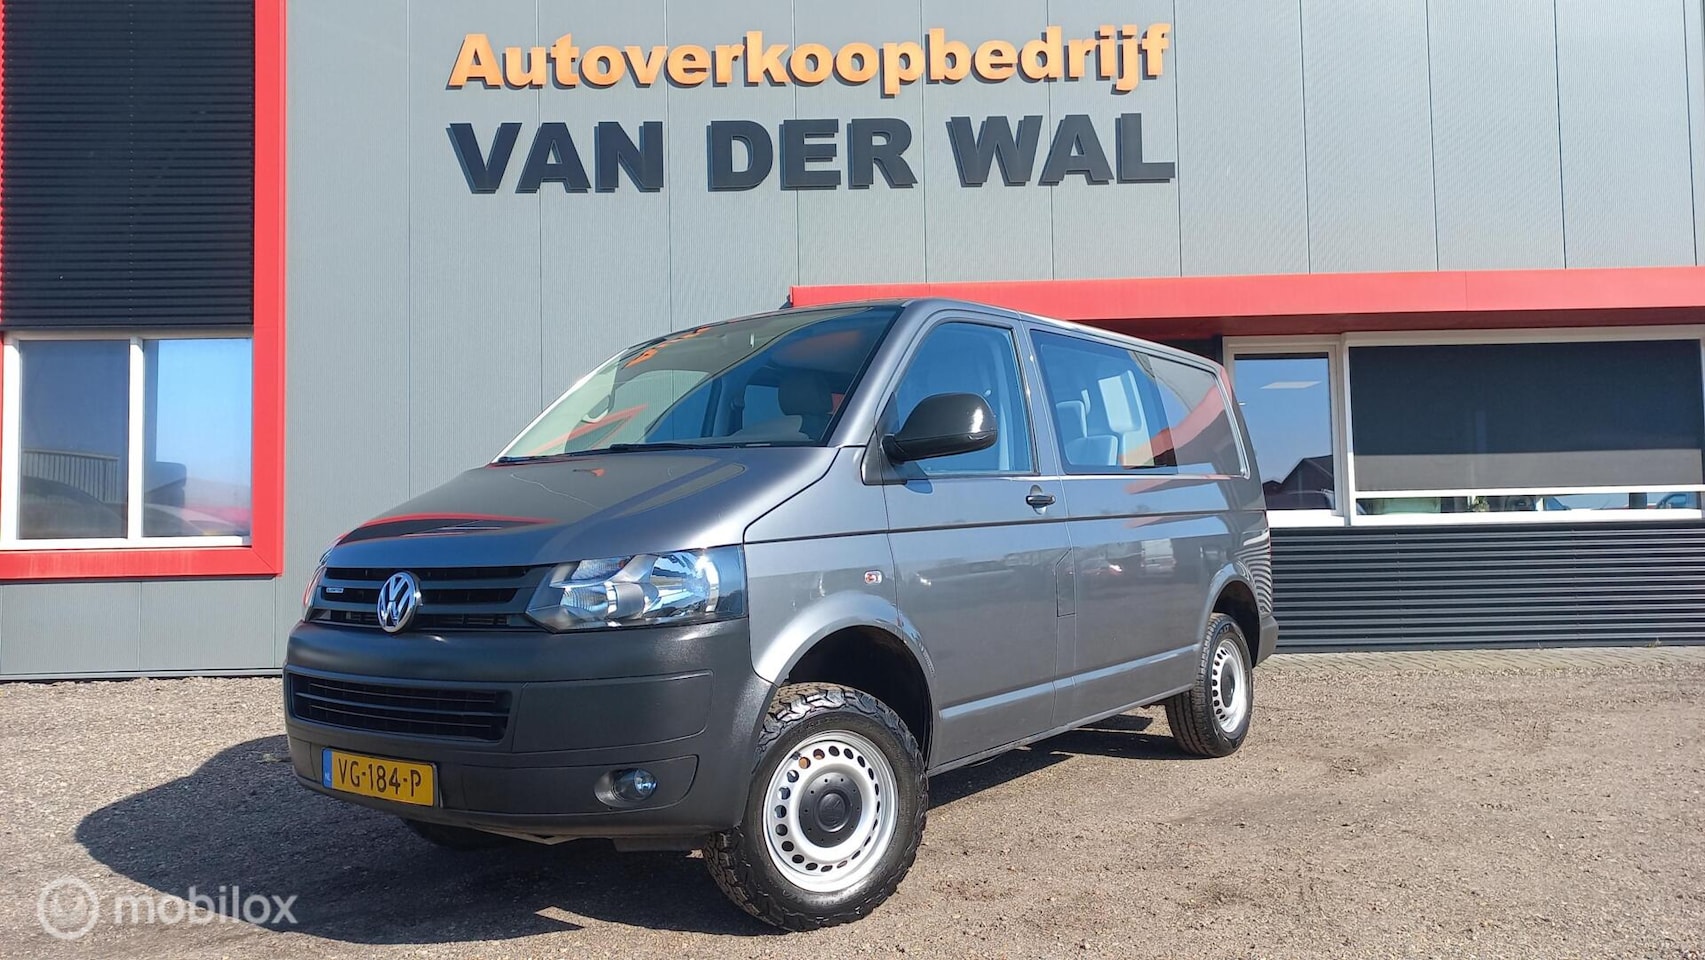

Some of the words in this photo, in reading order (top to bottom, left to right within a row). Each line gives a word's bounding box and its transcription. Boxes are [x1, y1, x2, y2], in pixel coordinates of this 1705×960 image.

[447, 23, 1171, 97] Autoverkoopbedrijf
[449, 122, 664, 194] VAN
[708, 118, 918, 192] DER
[947, 113, 1177, 187] WAL
[377, 571, 416, 633] VW
[338, 758, 422, 797] VG-184-P
